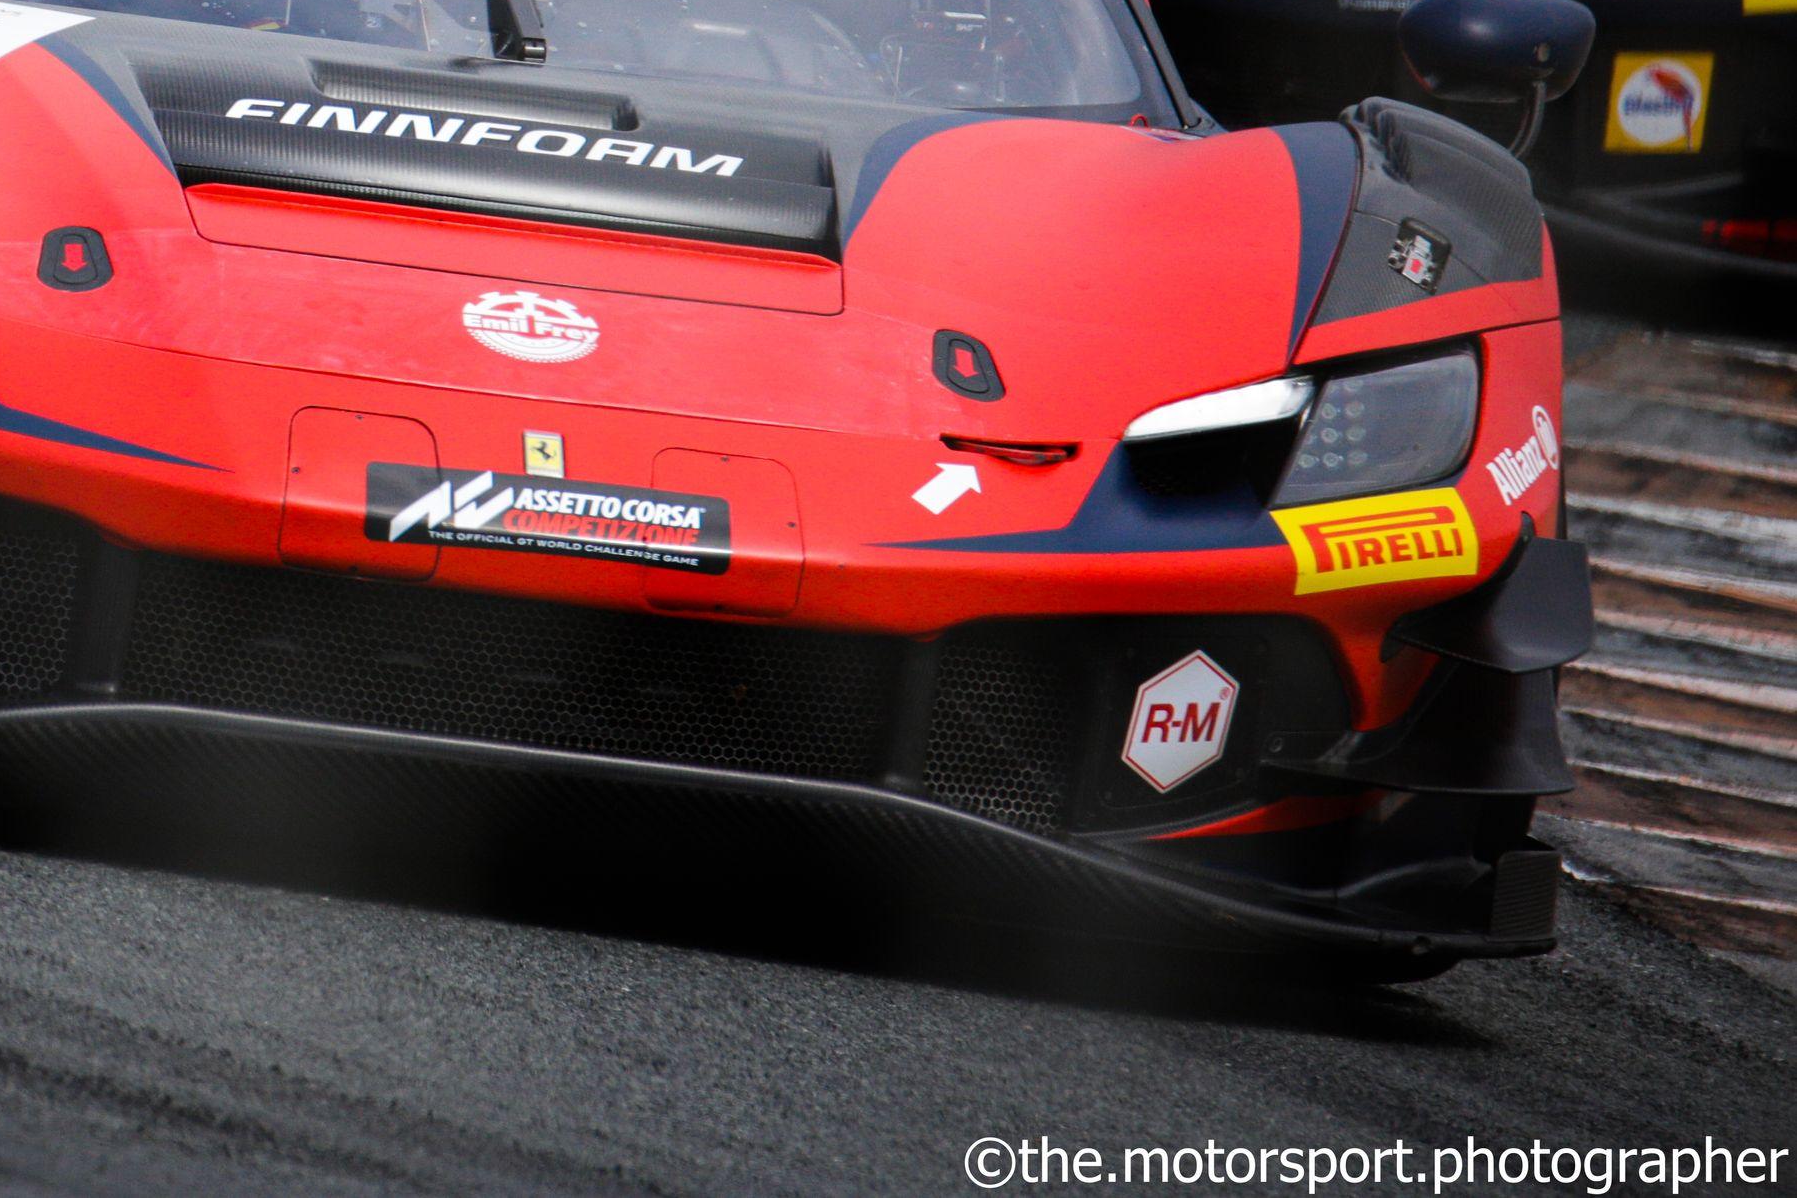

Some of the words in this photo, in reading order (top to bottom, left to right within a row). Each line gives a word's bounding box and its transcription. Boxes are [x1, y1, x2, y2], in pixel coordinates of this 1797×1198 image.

[224, 98, 745, 177] FINNFOAM
[463, 312, 530, 335] Emil
[533, 321, 601, 345] Frey
[1486, 435, 1547, 506] Allianz
[503, 508, 701, 549] COMPETIZIONE
[514, 487, 620, 519] ASSETTO
[621, 499, 702, 530] CORSA
[429, 530, 453, 540] THE
[455, 533, 514, 546] OFFICIAL
[516, 537, 534, 547] GT
[536, 539, 582, 552] WORLD
[583, 543, 661, 561] CHALLENGE
[662, 554, 700, 567] GAME
[1300, 505, 1463, 574] PIRELLI
